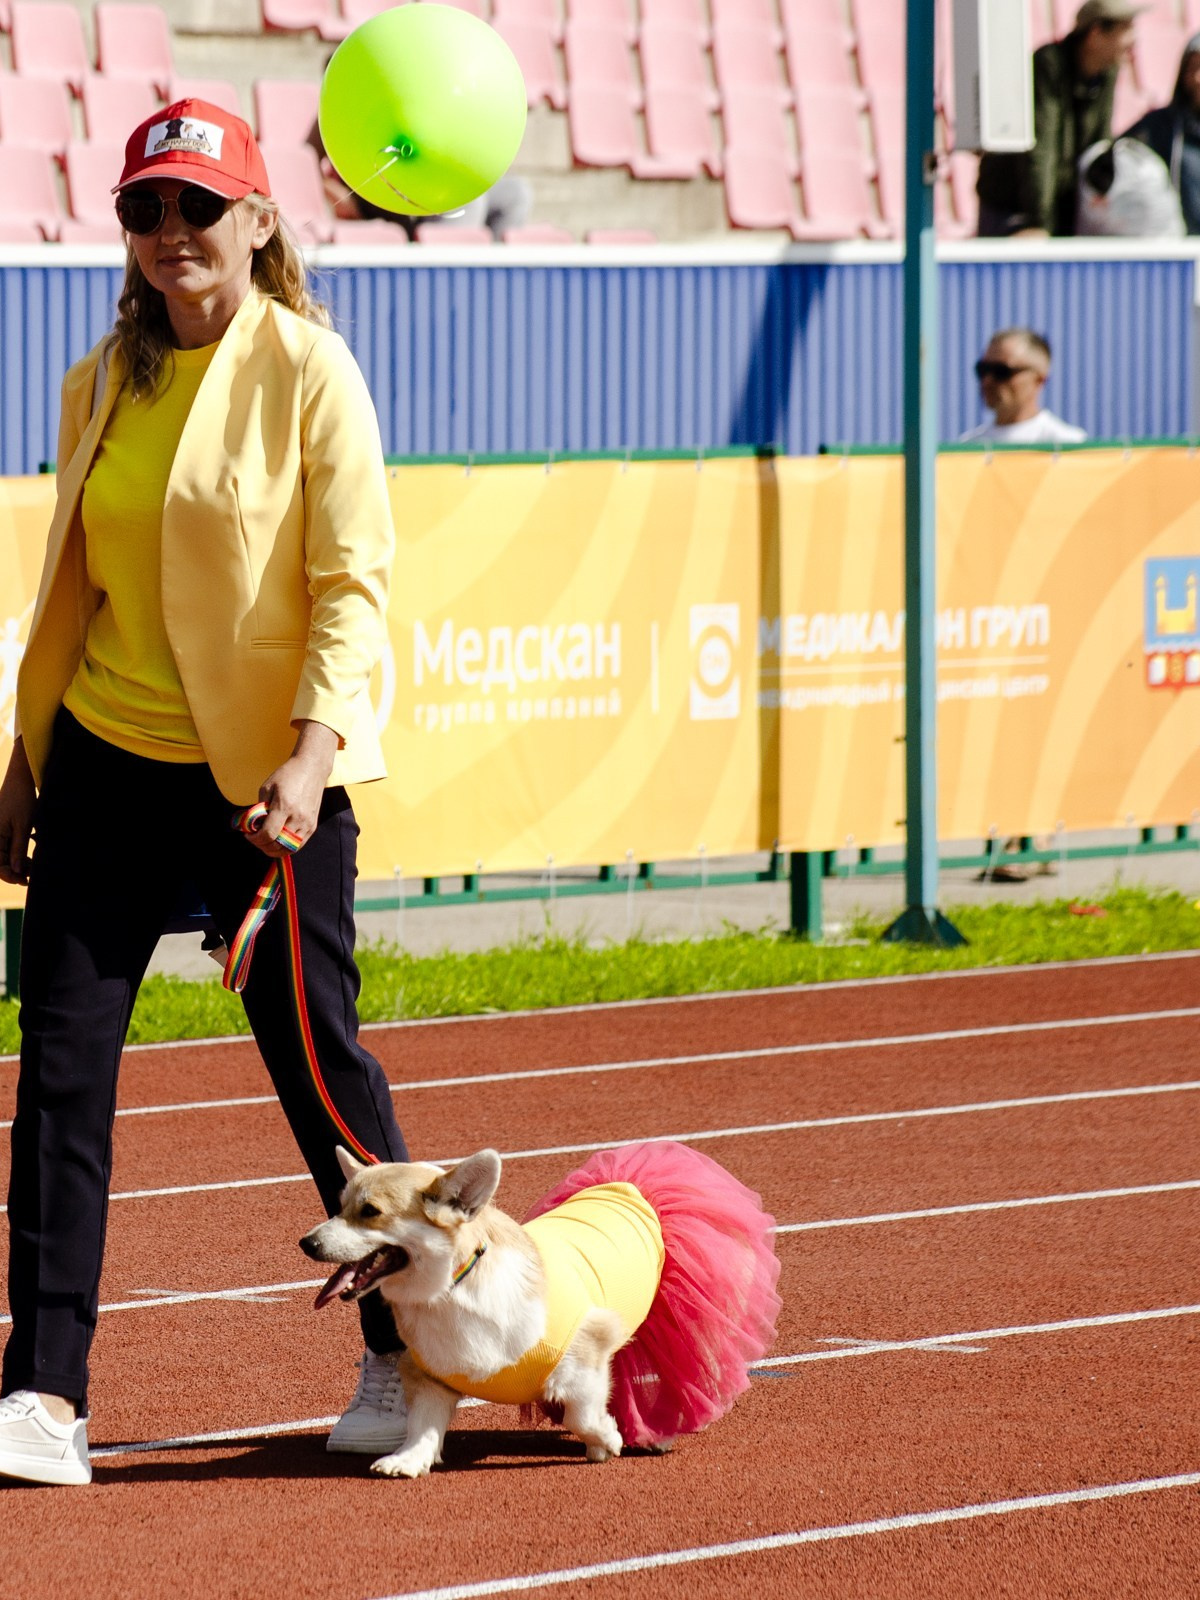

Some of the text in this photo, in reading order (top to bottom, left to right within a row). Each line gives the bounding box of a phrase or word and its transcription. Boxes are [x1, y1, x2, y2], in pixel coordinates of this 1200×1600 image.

[970, 603, 1050, 648] ГРУП
[413, 618, 621, 695] Медскан
[414, 687, 621, 734] группа компаний
